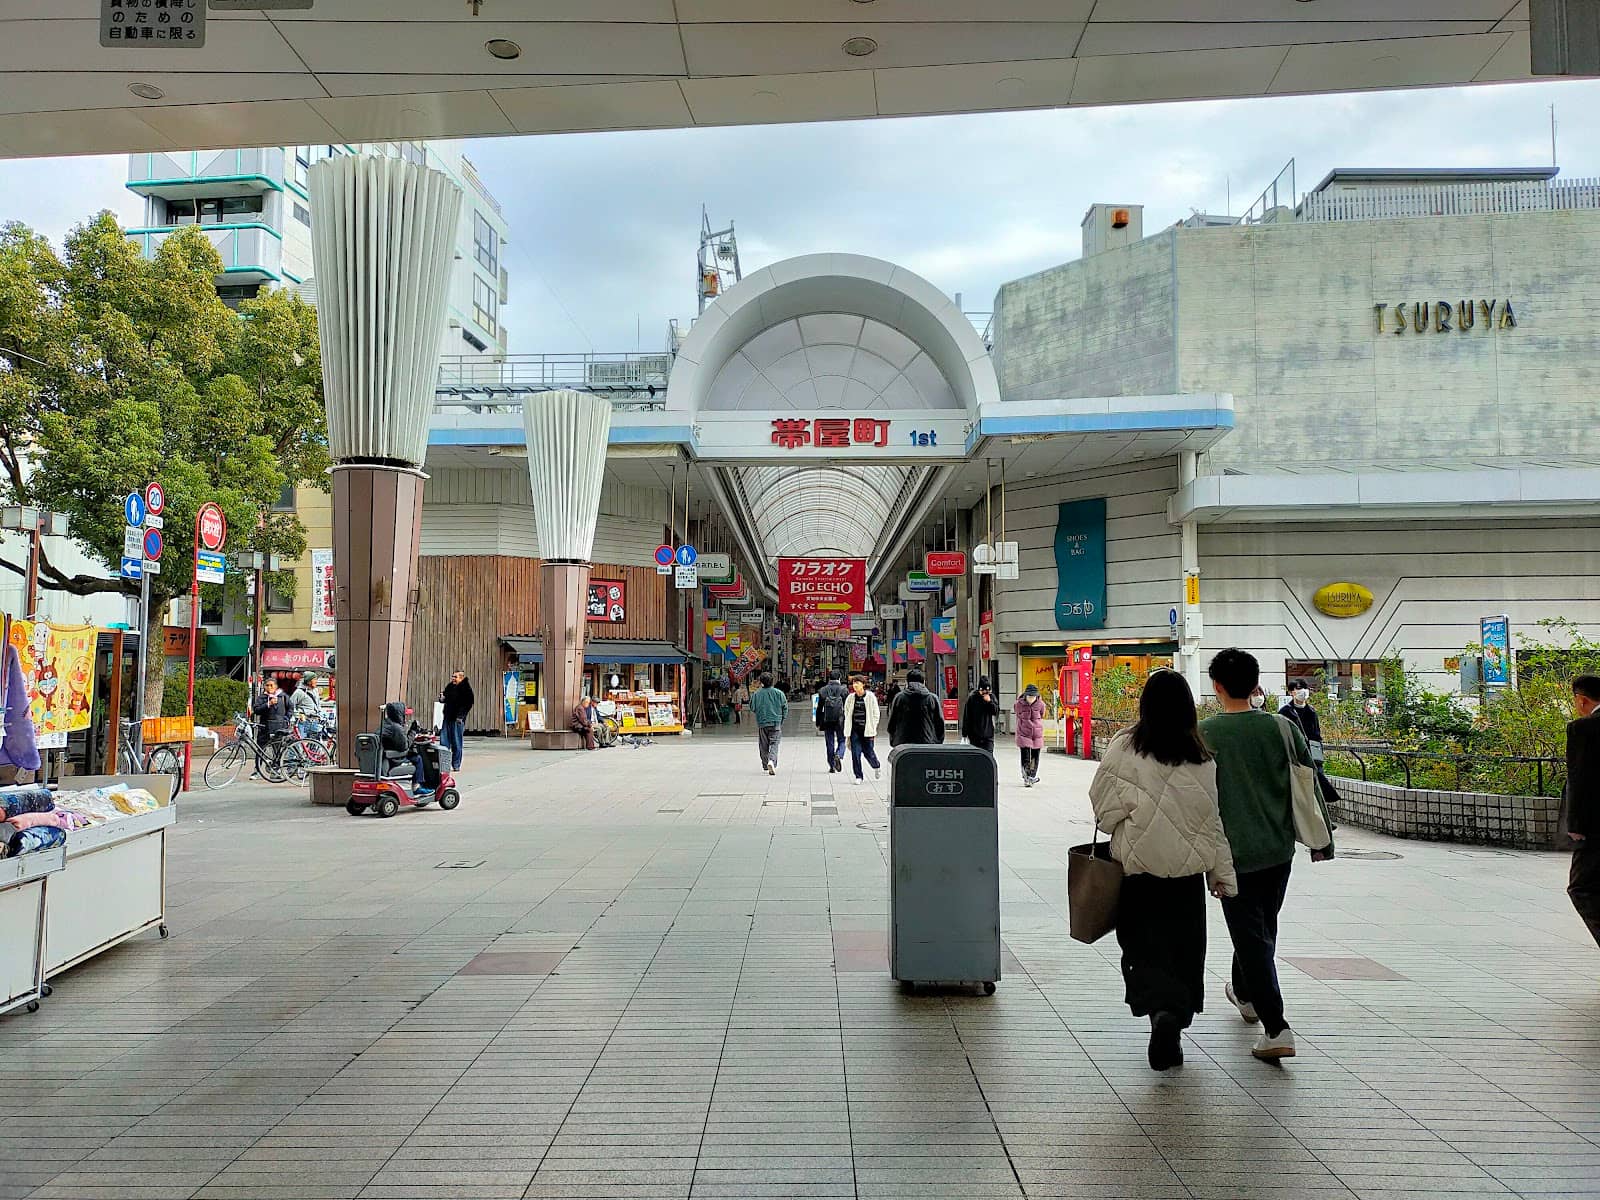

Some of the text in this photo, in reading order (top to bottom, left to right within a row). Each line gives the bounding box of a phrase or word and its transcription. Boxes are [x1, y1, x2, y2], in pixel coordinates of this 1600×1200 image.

[112, 11, 194, 24] のための
[109, 27, 196, 40] 自動車に限る
[1373, 299, 1518, 334] TSURUYA
[771, 418, 937, 449] 帯屋町 1st
[150, 491, 161, 507] 20
[791, 562, 853, 576] カラオケ
[931, 559, 961, 567] Comfort
[790, 582, 853, 594] BIG ECHO
[281, 652, 322, 665] 赤のれん
[925, 769, 964, 779] PUSH
[933, 783, 956, 793] おす
